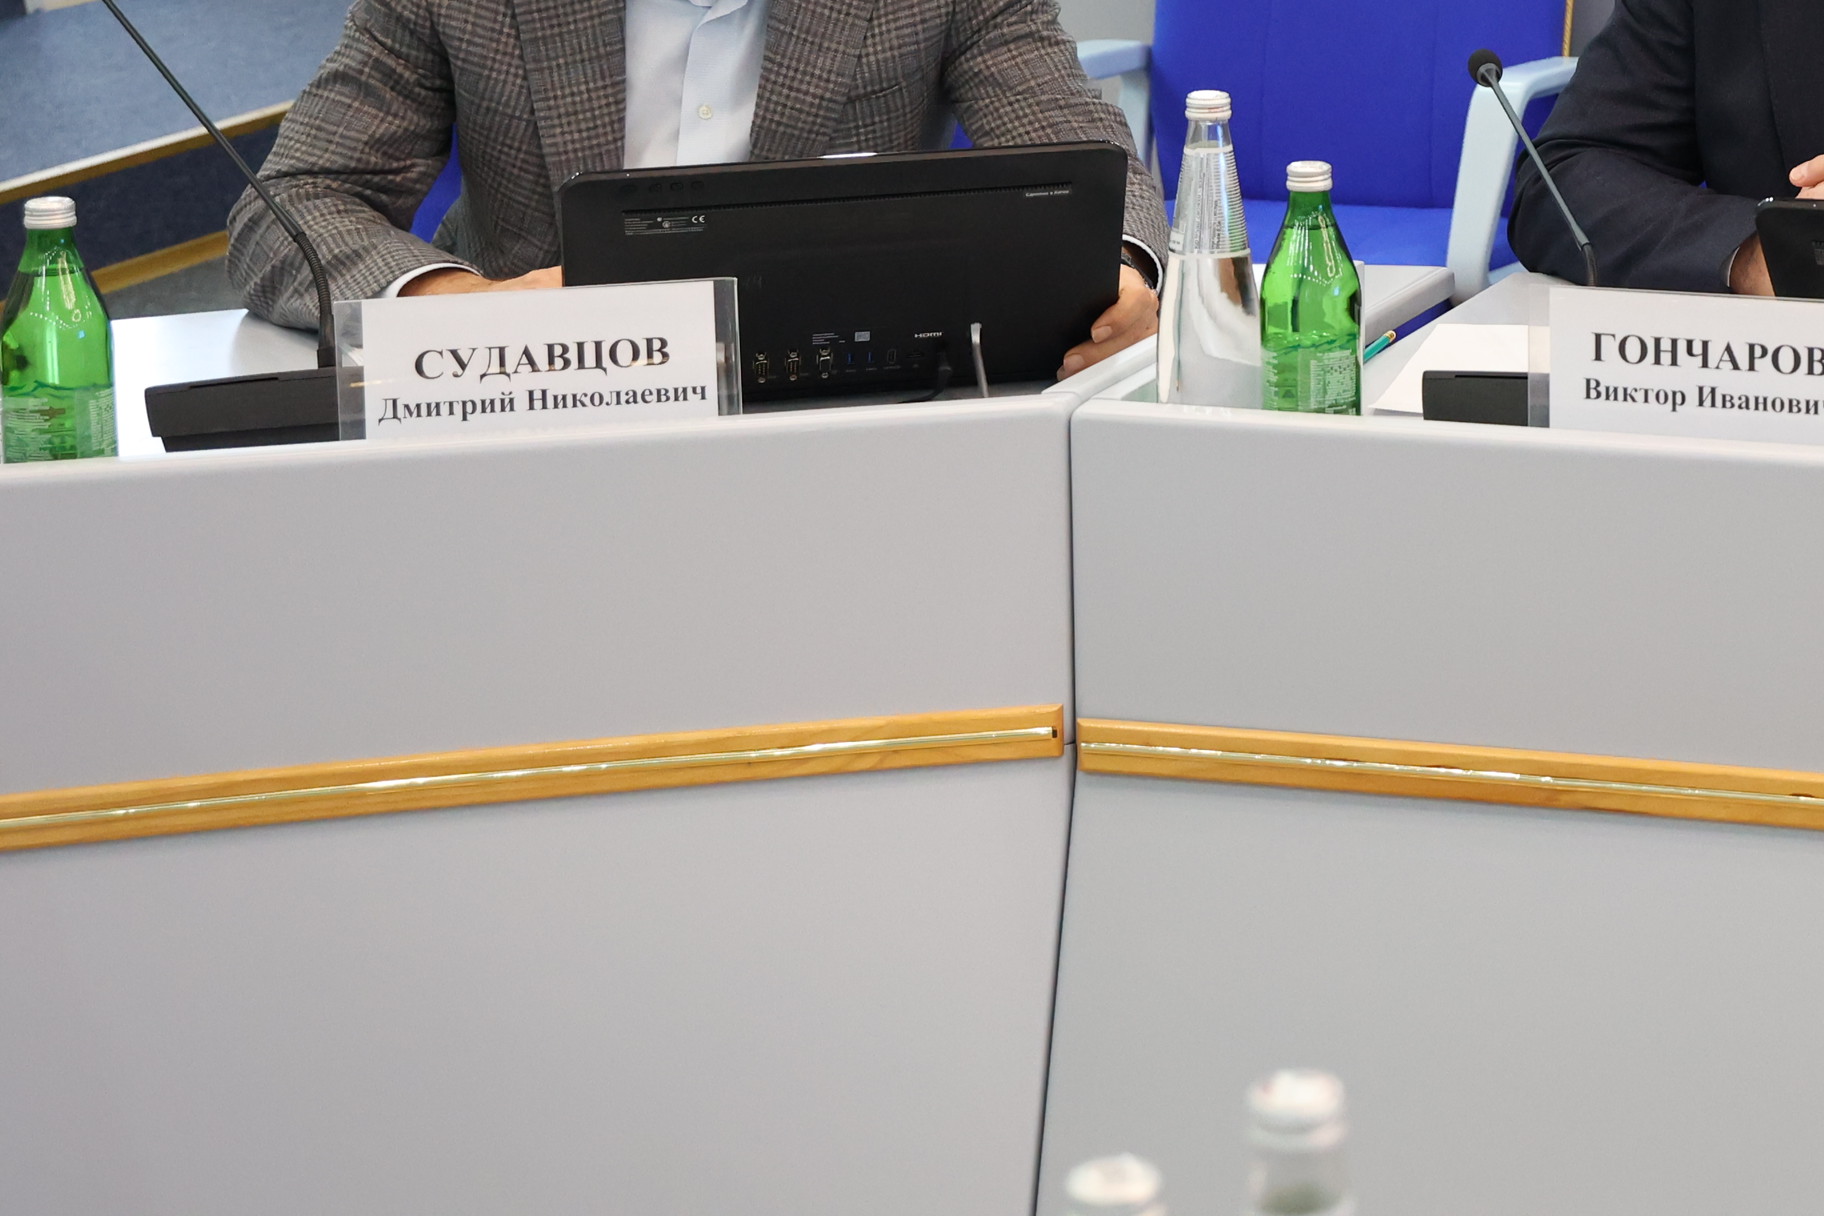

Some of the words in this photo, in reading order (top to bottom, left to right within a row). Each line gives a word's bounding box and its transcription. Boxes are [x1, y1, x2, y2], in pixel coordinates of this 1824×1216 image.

[414, 336, 670, 384] СУДАВЦОВ
[378, 390, 516, 426] Дмитрий
[527, 385, 707, 411] Николаевич
[1583, 377, 1686, 412] Виктор
